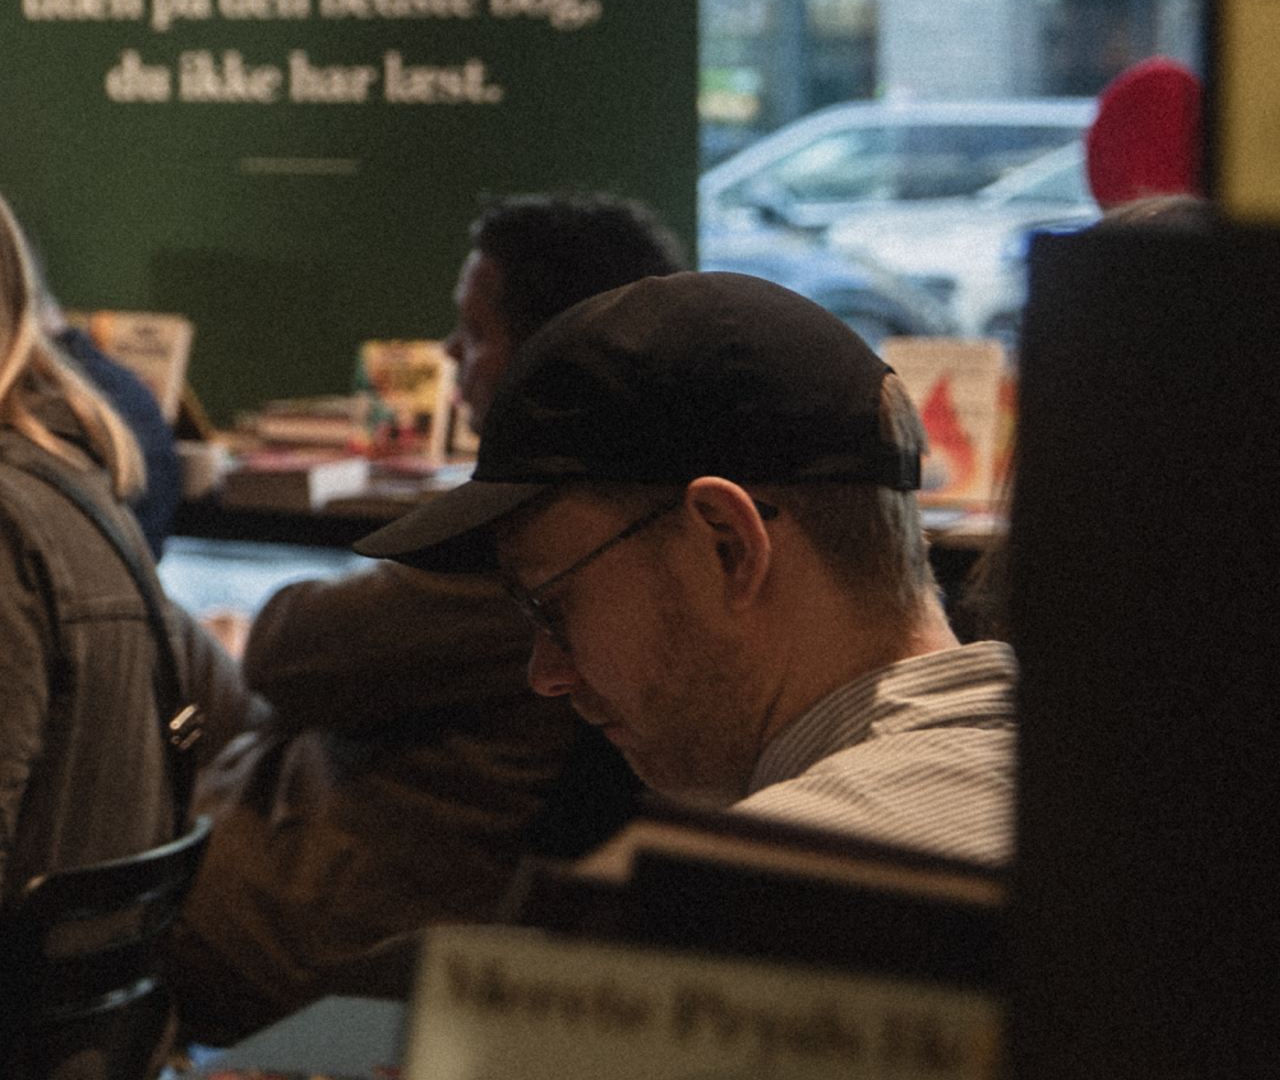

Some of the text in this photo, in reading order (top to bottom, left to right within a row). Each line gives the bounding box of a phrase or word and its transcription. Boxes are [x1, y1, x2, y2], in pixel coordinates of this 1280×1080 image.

[104, 48, 502, 104] du ikke har læst.
